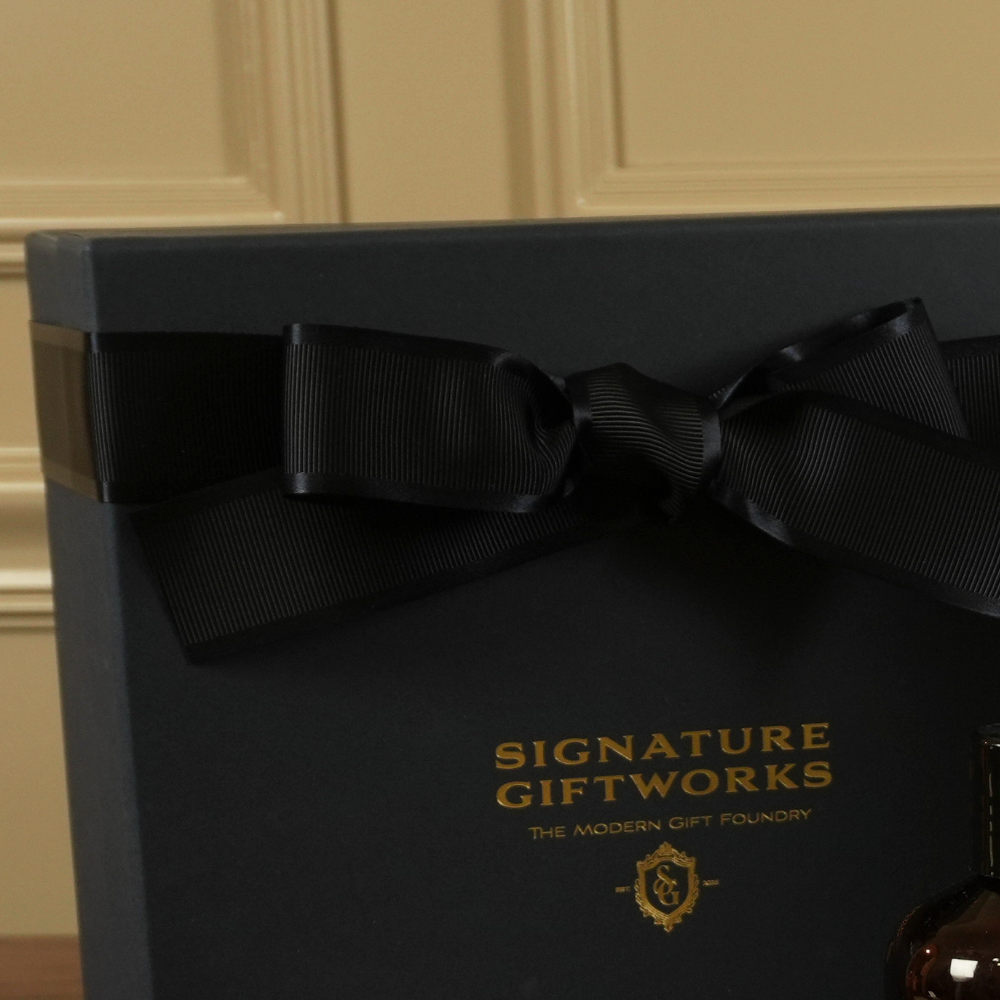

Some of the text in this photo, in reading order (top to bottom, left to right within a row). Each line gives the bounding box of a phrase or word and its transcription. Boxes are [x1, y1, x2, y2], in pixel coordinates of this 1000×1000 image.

[495, 722, 830, 770] SIGNATURE
[495, 760, 832, 809] GIFTWORKS
[528, 809, 812, 840] THE MODERN GIFT FOUNDRY
